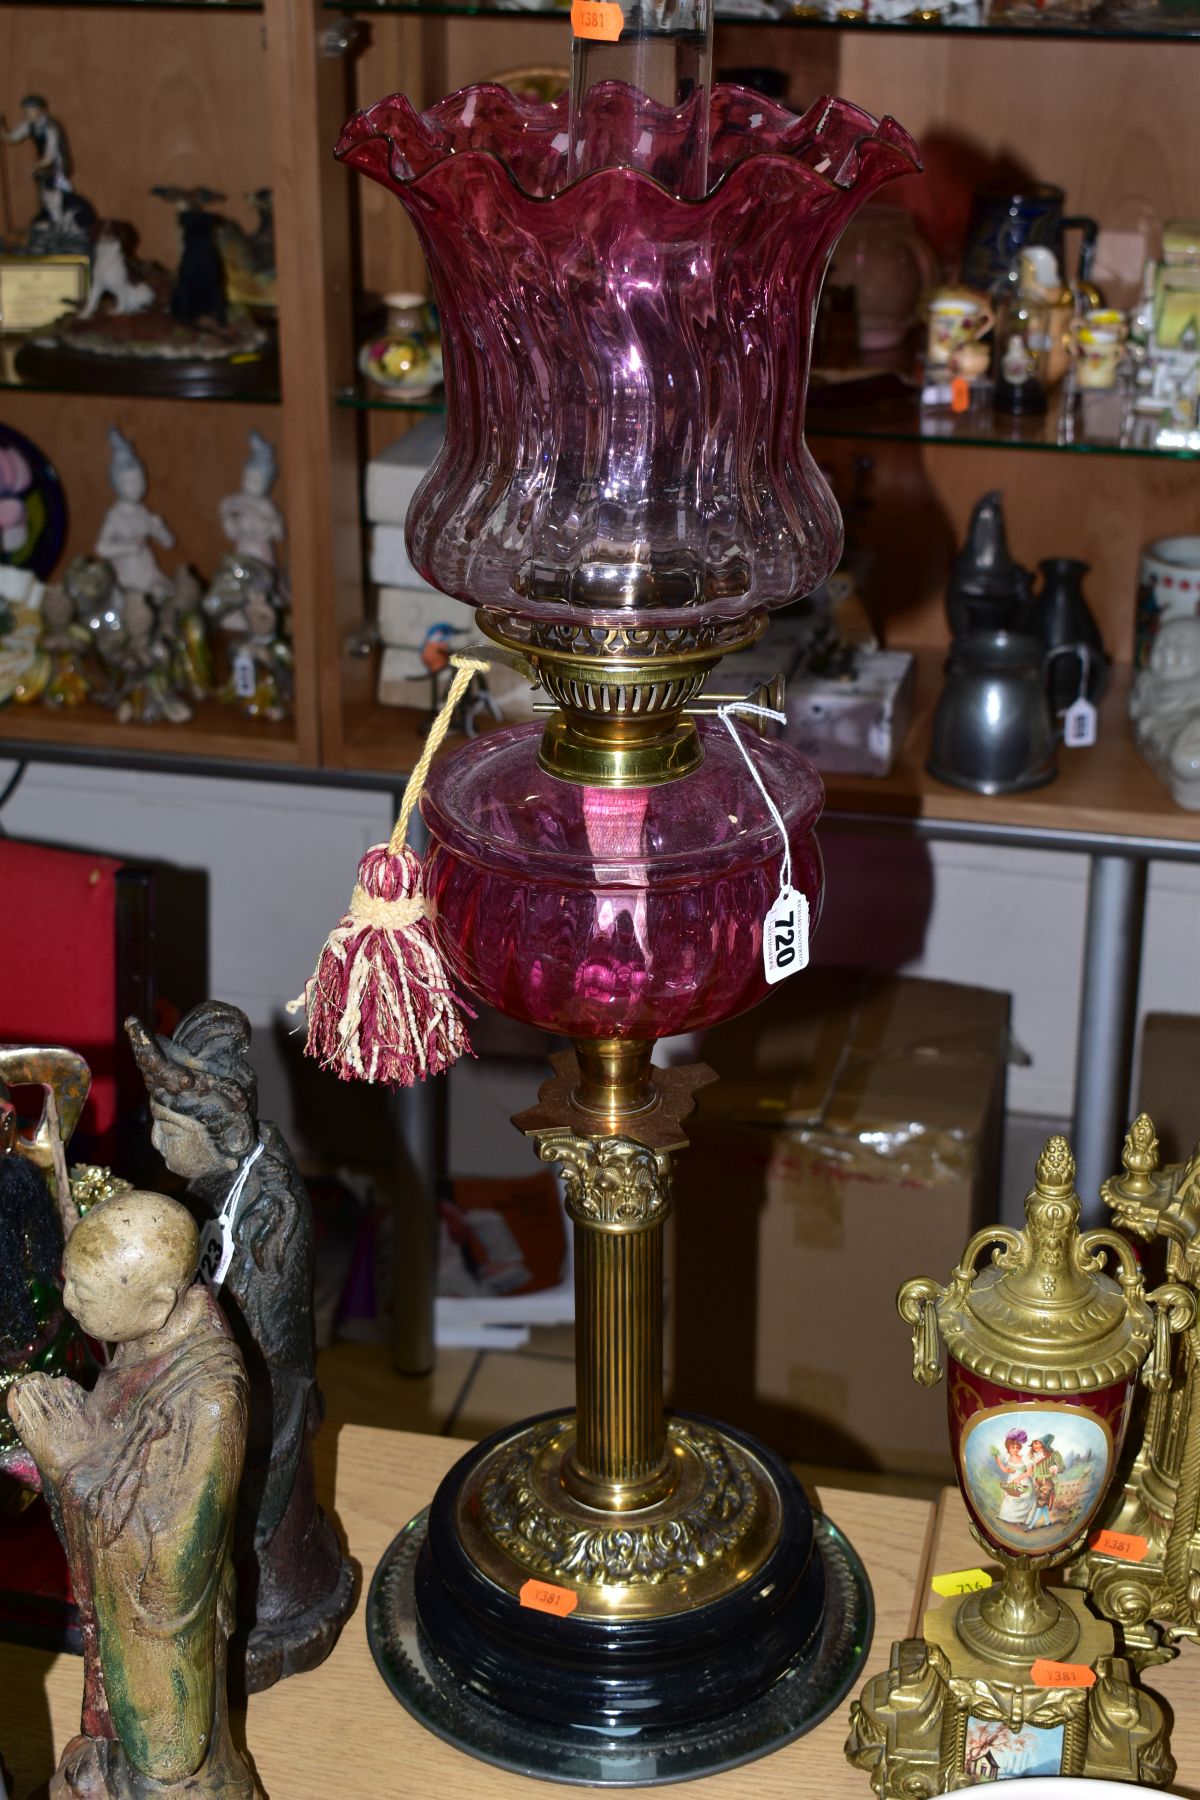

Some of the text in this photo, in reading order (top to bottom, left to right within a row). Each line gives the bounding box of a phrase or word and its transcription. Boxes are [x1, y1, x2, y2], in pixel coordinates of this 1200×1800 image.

[580, 11, 604, 28] Y381
[774, 910, 796, 968] 720
[1104, 1537, 1131, 1553] Y381
[535, 1588, 561, 1606] Y381
[1046, 1669, 1077, 1681] Y381
